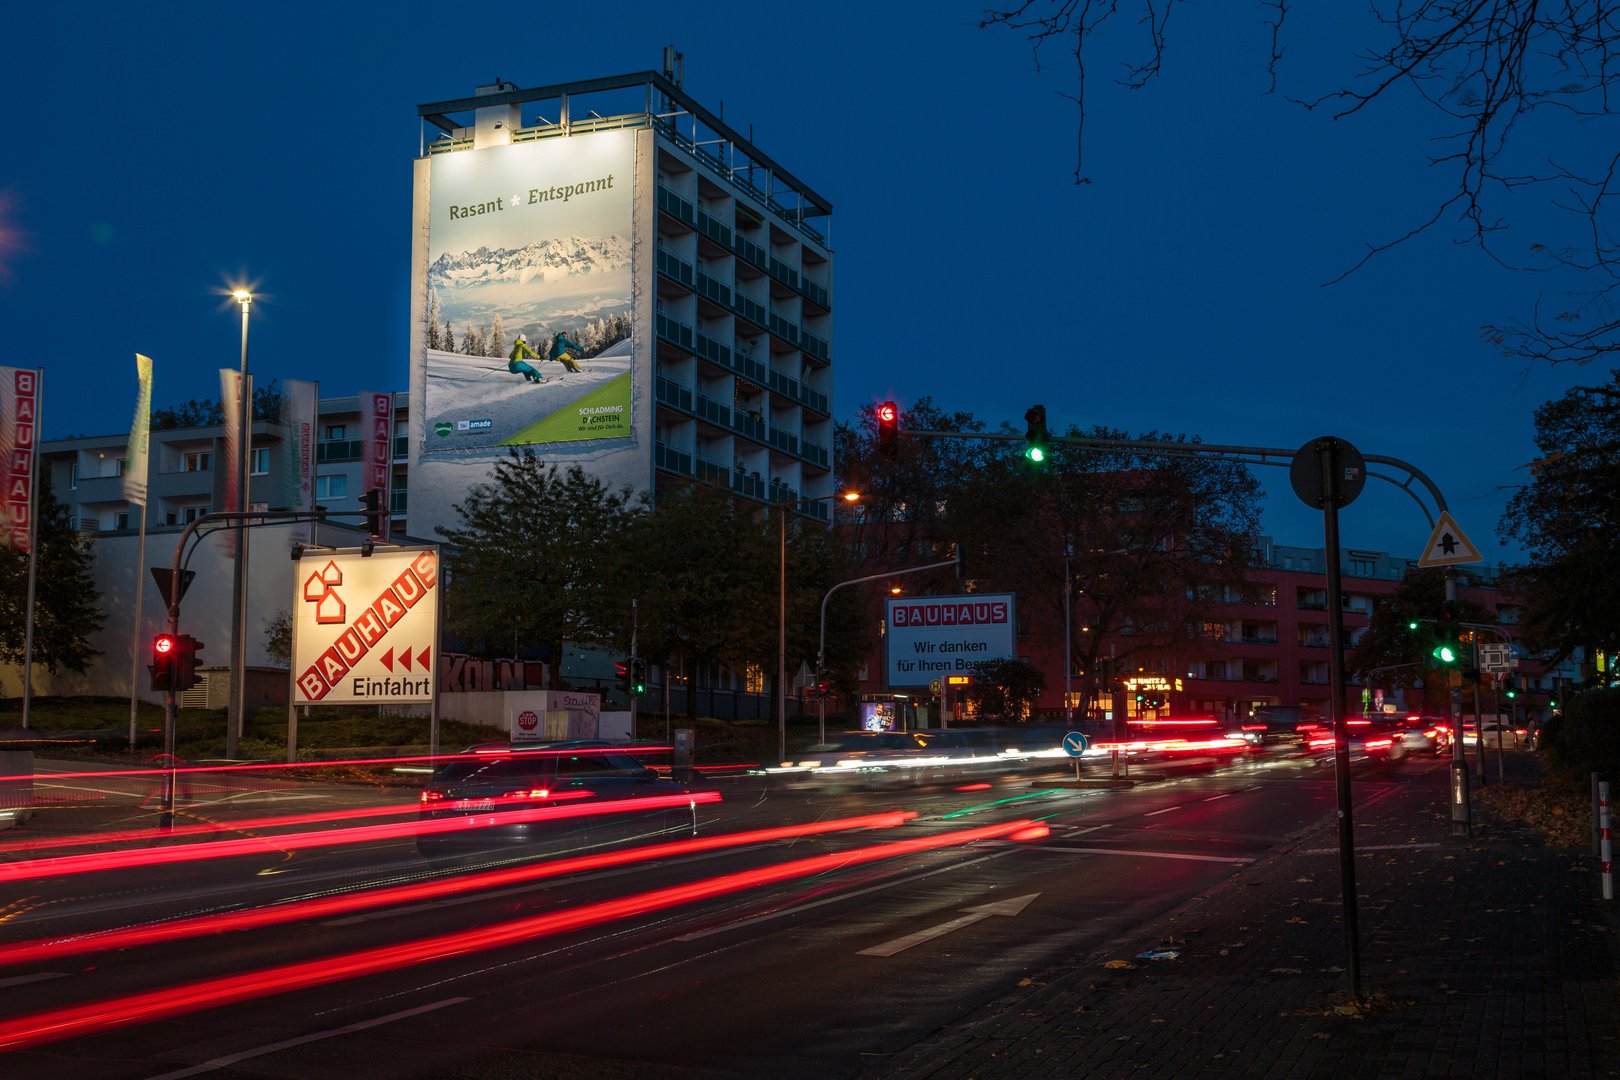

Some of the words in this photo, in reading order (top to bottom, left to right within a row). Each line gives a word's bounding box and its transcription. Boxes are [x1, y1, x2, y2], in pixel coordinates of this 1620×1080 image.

[449, 196, 504, 221] Rasant
[527, 174, 614, 205] Entspannt
[578, 404, 624, 416] SCHLADMING
[582, 414, 620, 425] DACHSTEIN
[894, 603, 1006, 625] BAUHAUS
[299, 552, 437, 700] BAUHAUS
[914, 641, 936, 653] Wir
[939, 640, 987, 653] danken
[897, 659, 916, 672] für
[918, 658, 951, 671] Ihren
[353, 677, 430, 696] Einfahrt
[519, 716, 537, 726] STOP
